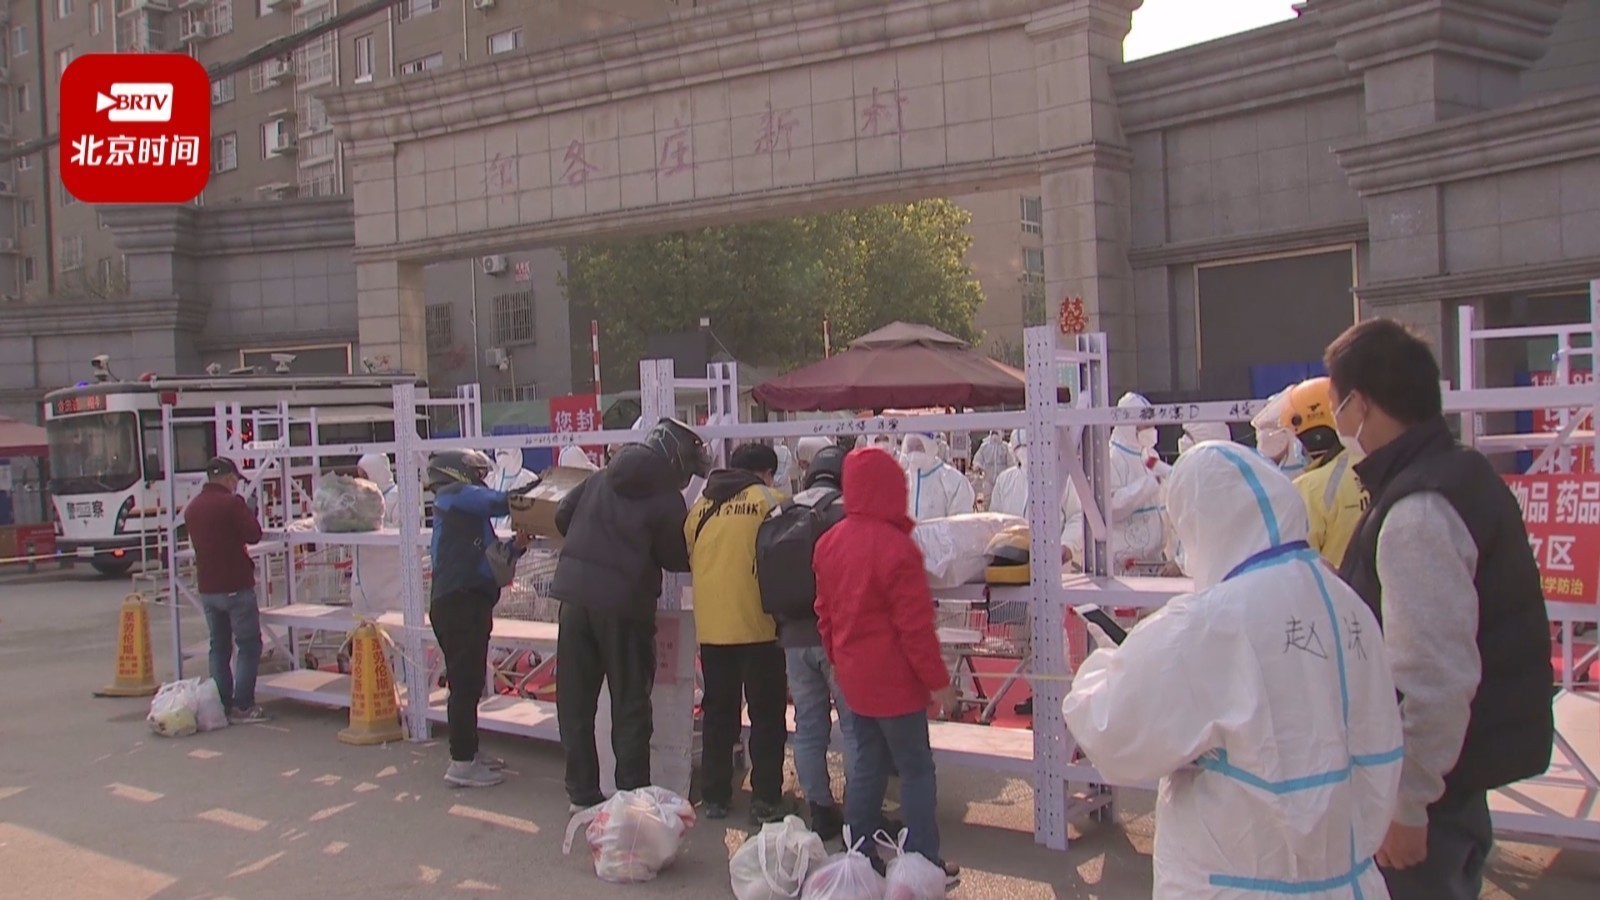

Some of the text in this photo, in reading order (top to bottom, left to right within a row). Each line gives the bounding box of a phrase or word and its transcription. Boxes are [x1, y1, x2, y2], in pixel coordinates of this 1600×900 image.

[1555, 480, 1600, 524] 药品
[1541, 577, 1584, 595] 学防治
